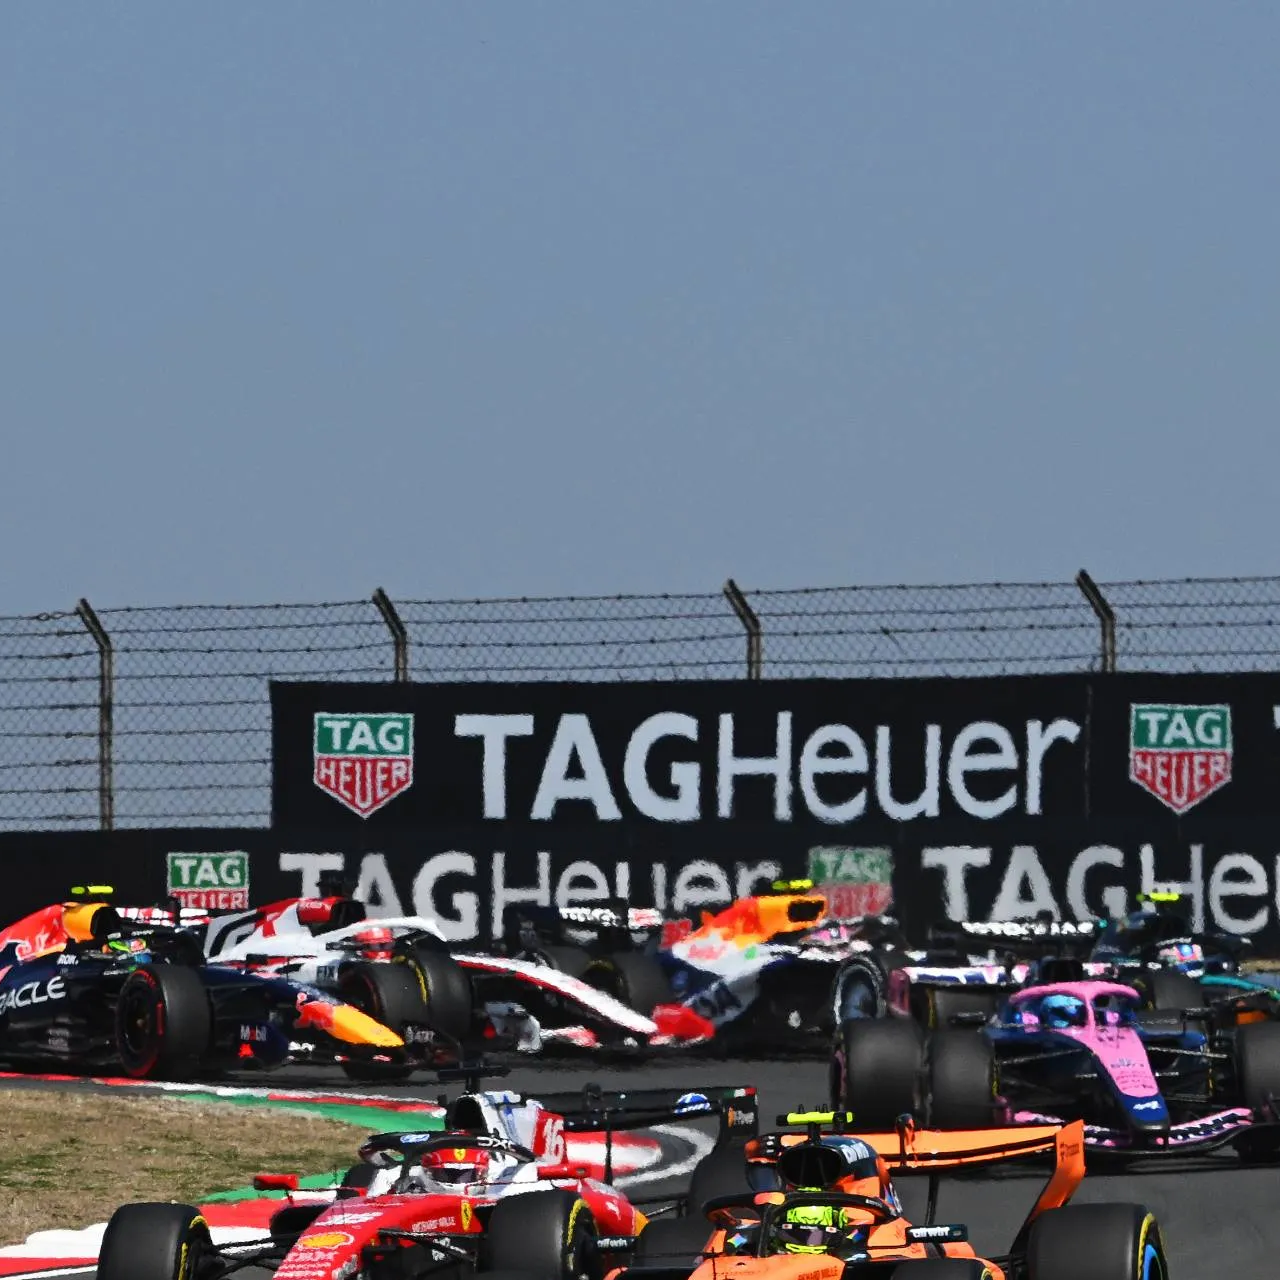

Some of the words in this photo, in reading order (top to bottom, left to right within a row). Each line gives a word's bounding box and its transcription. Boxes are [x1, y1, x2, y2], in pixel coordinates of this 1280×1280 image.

[324, 720, 405, 752] TAG
[1138, 710, 1221, 746] TAG
[320, 757, 409, 808] HEUER
[1135, 753, 1224, 809] HEUER
[175, 858, 241, 885] TAG
[543, 1117, 565, 1165] 16
